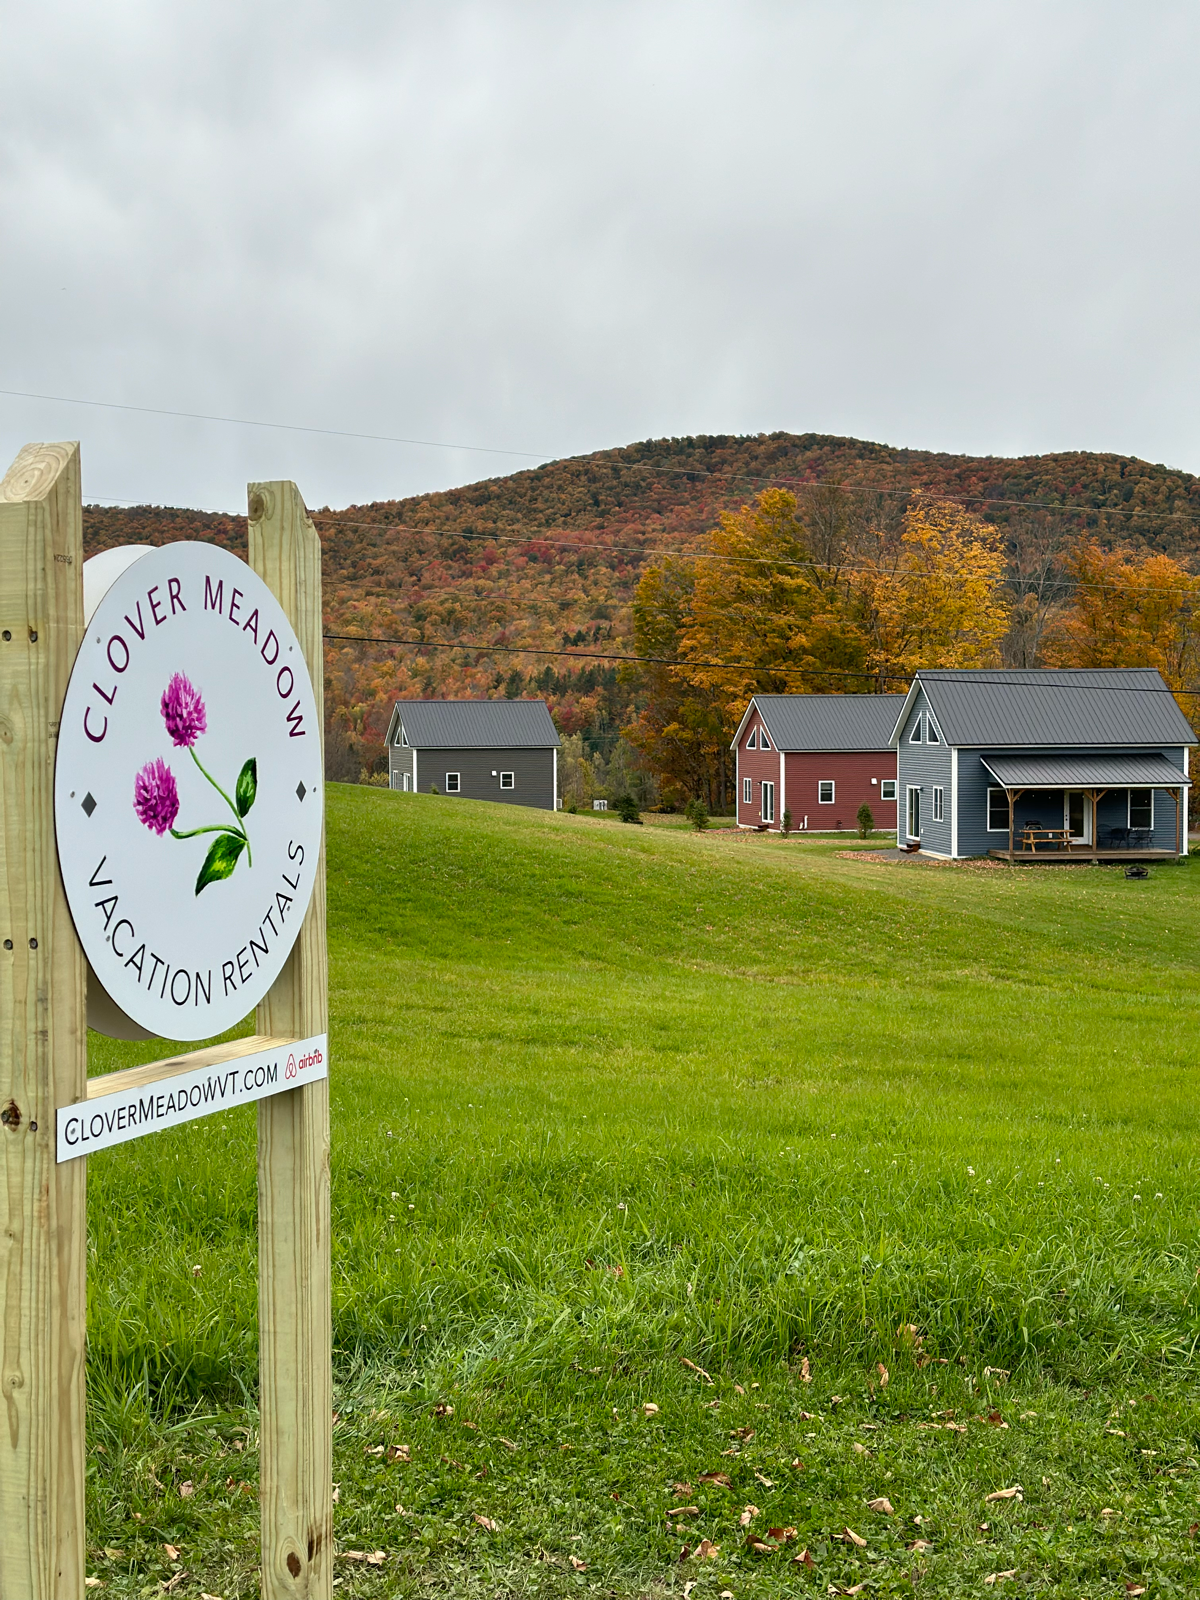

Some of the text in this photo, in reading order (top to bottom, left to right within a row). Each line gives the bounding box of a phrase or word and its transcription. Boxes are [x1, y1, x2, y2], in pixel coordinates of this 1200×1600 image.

[83, 575, 306, 743] CLOVER MEADOW
[88, 839, 305, 1007] VACATION RENTALS
[64, 1049, 323, 1146] CLOVERMEADOWVT.COM airbnb
